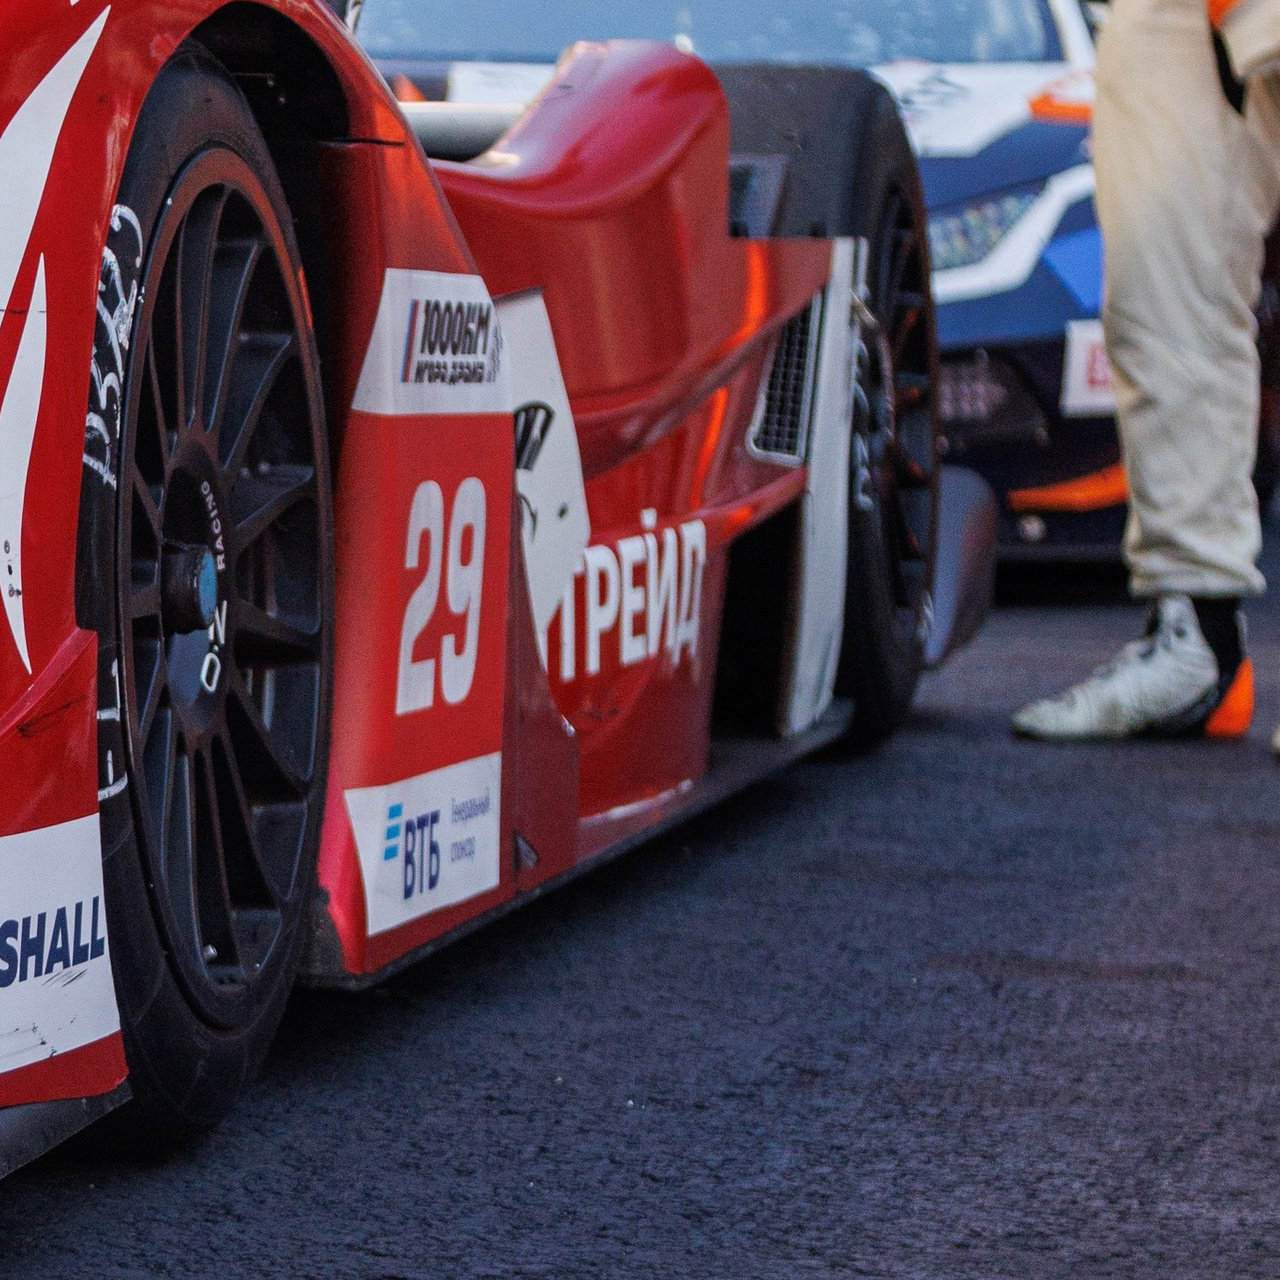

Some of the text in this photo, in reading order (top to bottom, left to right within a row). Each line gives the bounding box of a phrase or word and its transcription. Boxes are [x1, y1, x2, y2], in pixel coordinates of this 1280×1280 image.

[201, 480, 226, 571] RACING
[396, 476, 487, 716] 29
[403, 809, 441, 900] ВТБ
